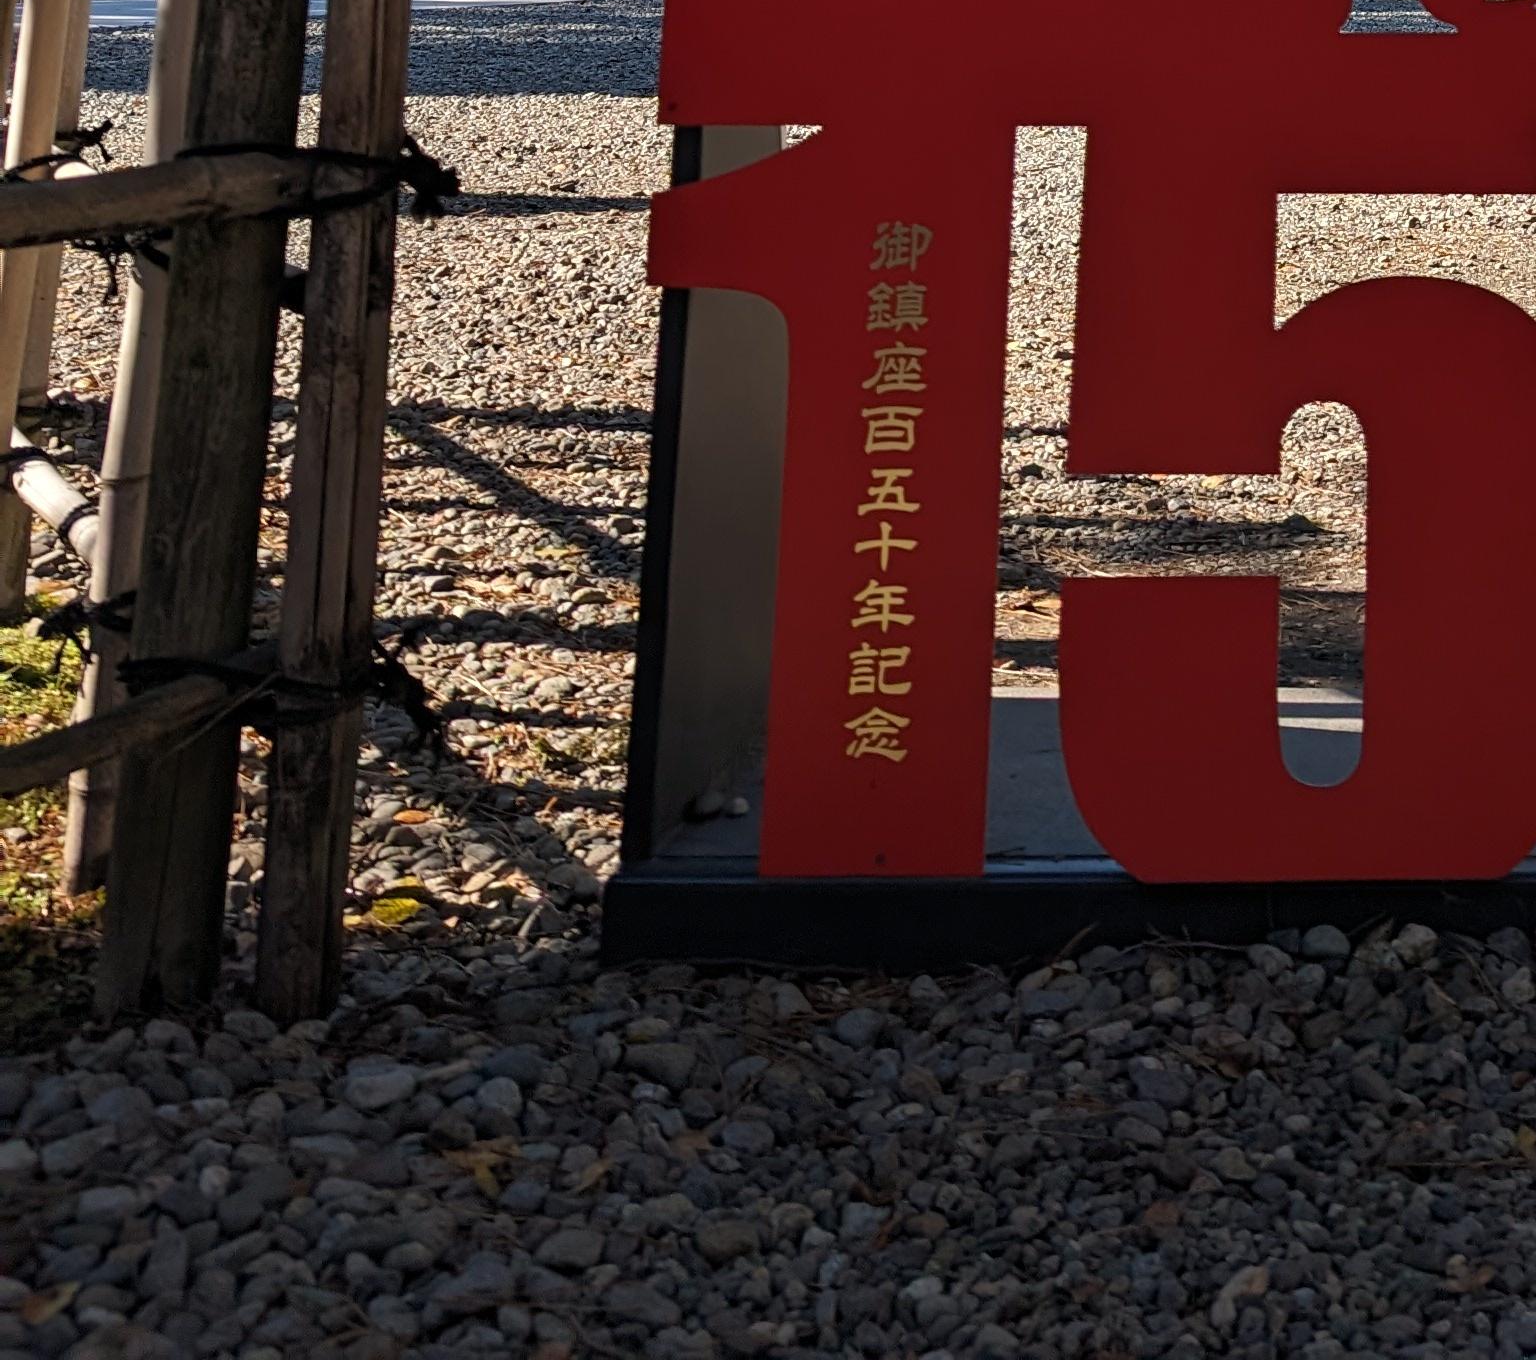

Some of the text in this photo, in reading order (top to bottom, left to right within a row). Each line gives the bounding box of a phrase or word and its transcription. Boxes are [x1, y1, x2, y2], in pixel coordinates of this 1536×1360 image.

[843, 220, 933, 763] 御鎮座百五十年記念
